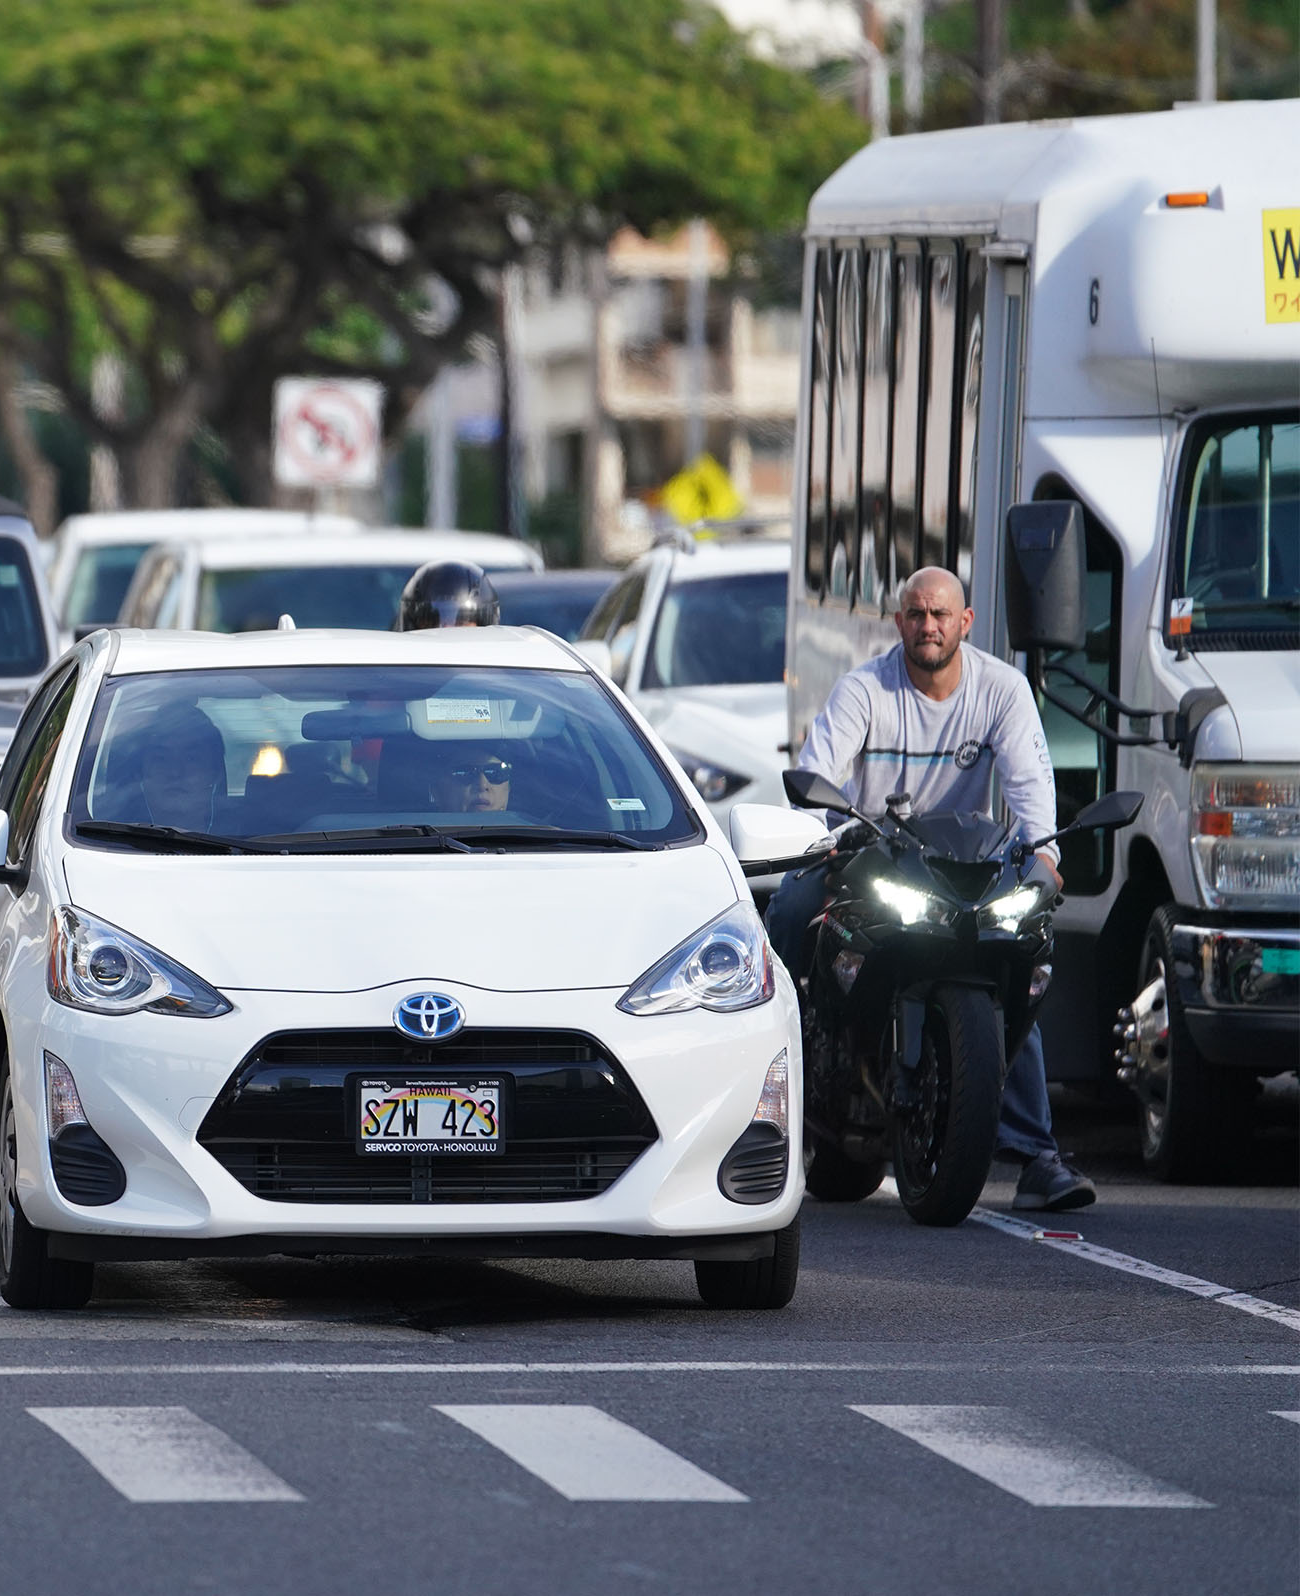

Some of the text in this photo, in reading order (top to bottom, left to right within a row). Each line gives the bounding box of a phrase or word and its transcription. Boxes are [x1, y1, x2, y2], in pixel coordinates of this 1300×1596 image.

[1089, 278, 1101, 325] 6
[409, 1088, 451, 1097] HAWAII
[364, 1099, 496, 1137] SZW 423
[365, 1143, 401, 1152] SERVCO
